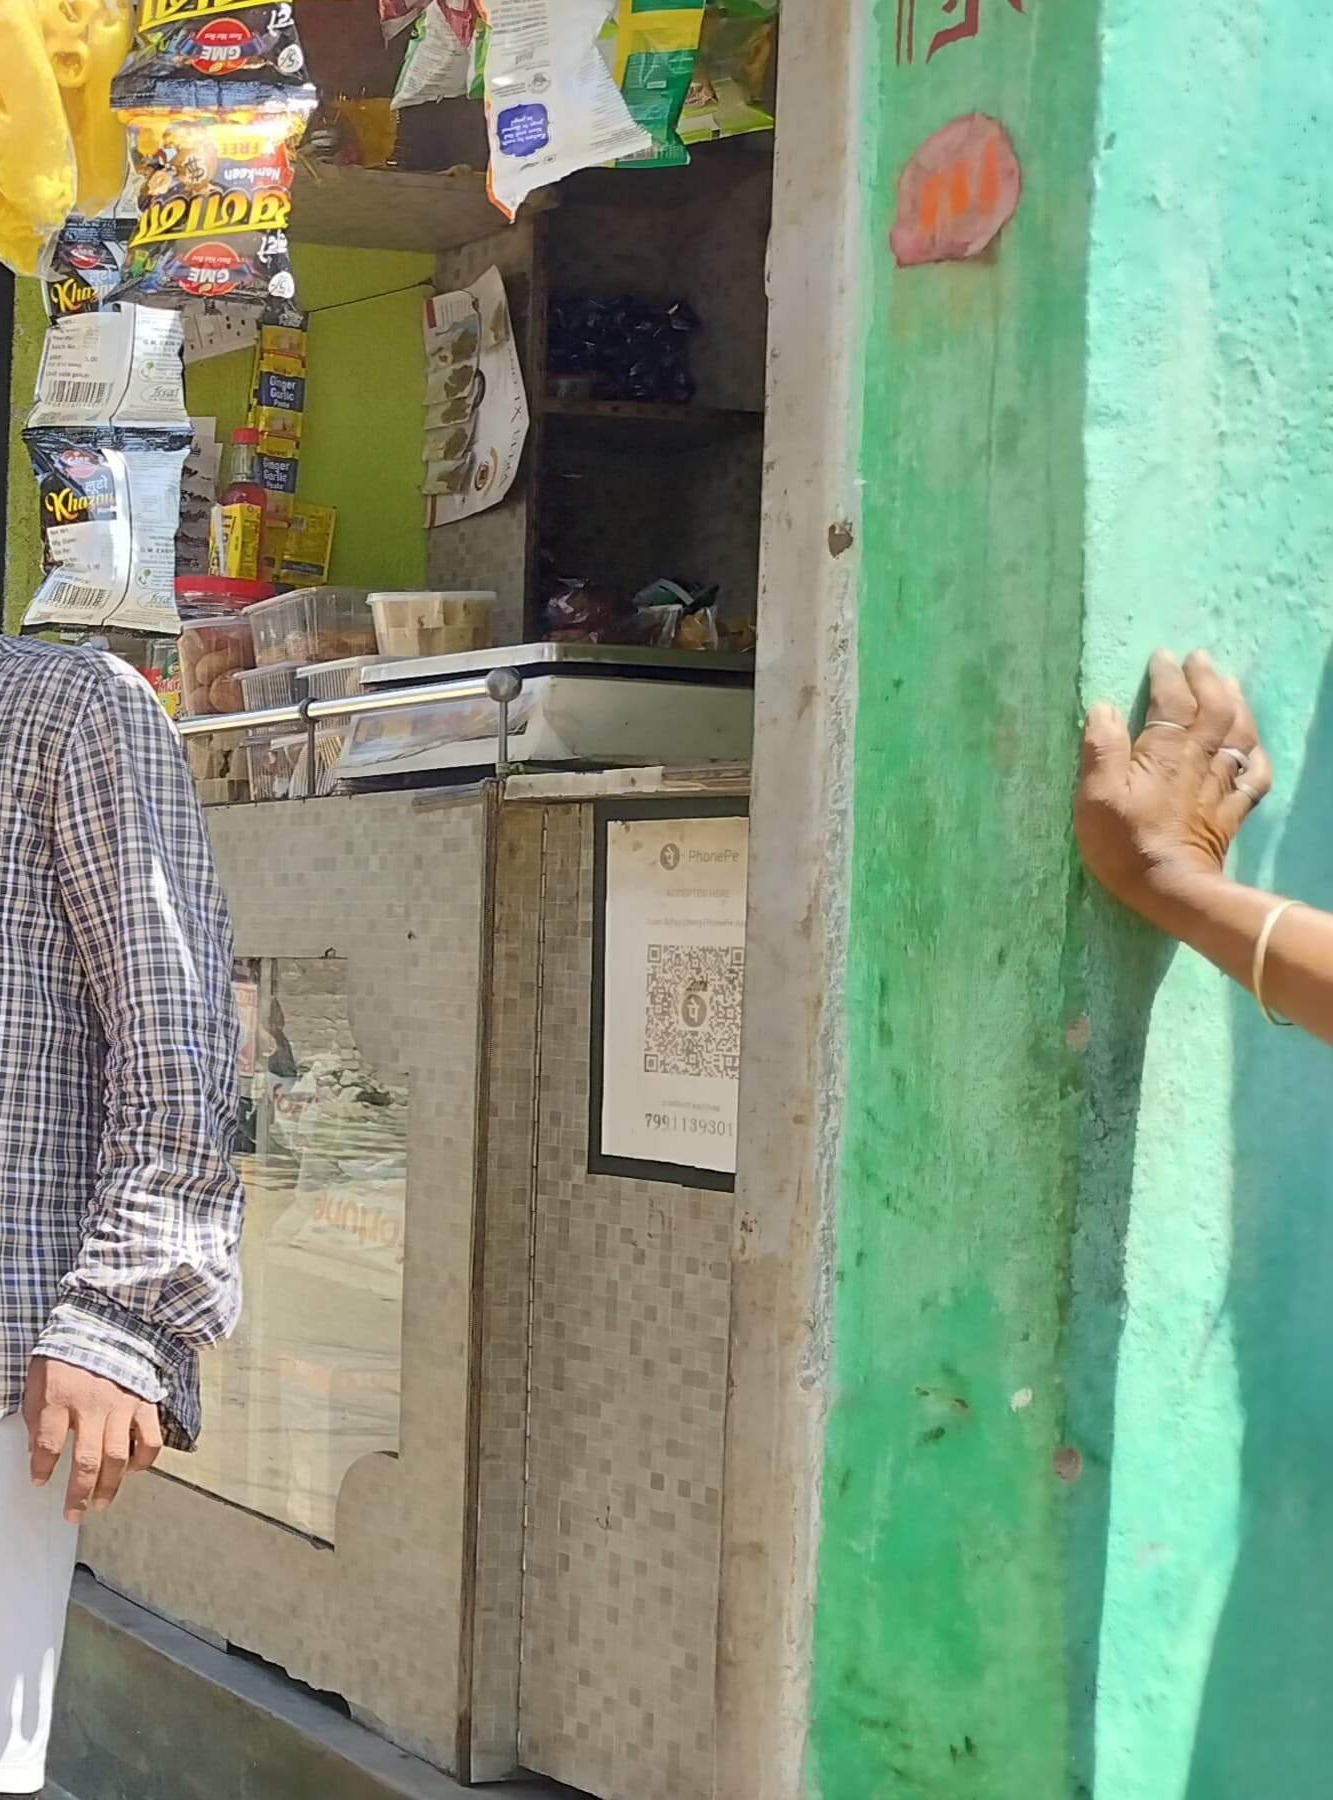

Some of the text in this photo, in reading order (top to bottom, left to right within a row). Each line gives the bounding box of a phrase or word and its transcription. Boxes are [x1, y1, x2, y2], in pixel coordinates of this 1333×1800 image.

[201, 45, 241, 61] GME
[187, 268, 230, 283] GME
[688, 849, 740, 863] PhonePe
